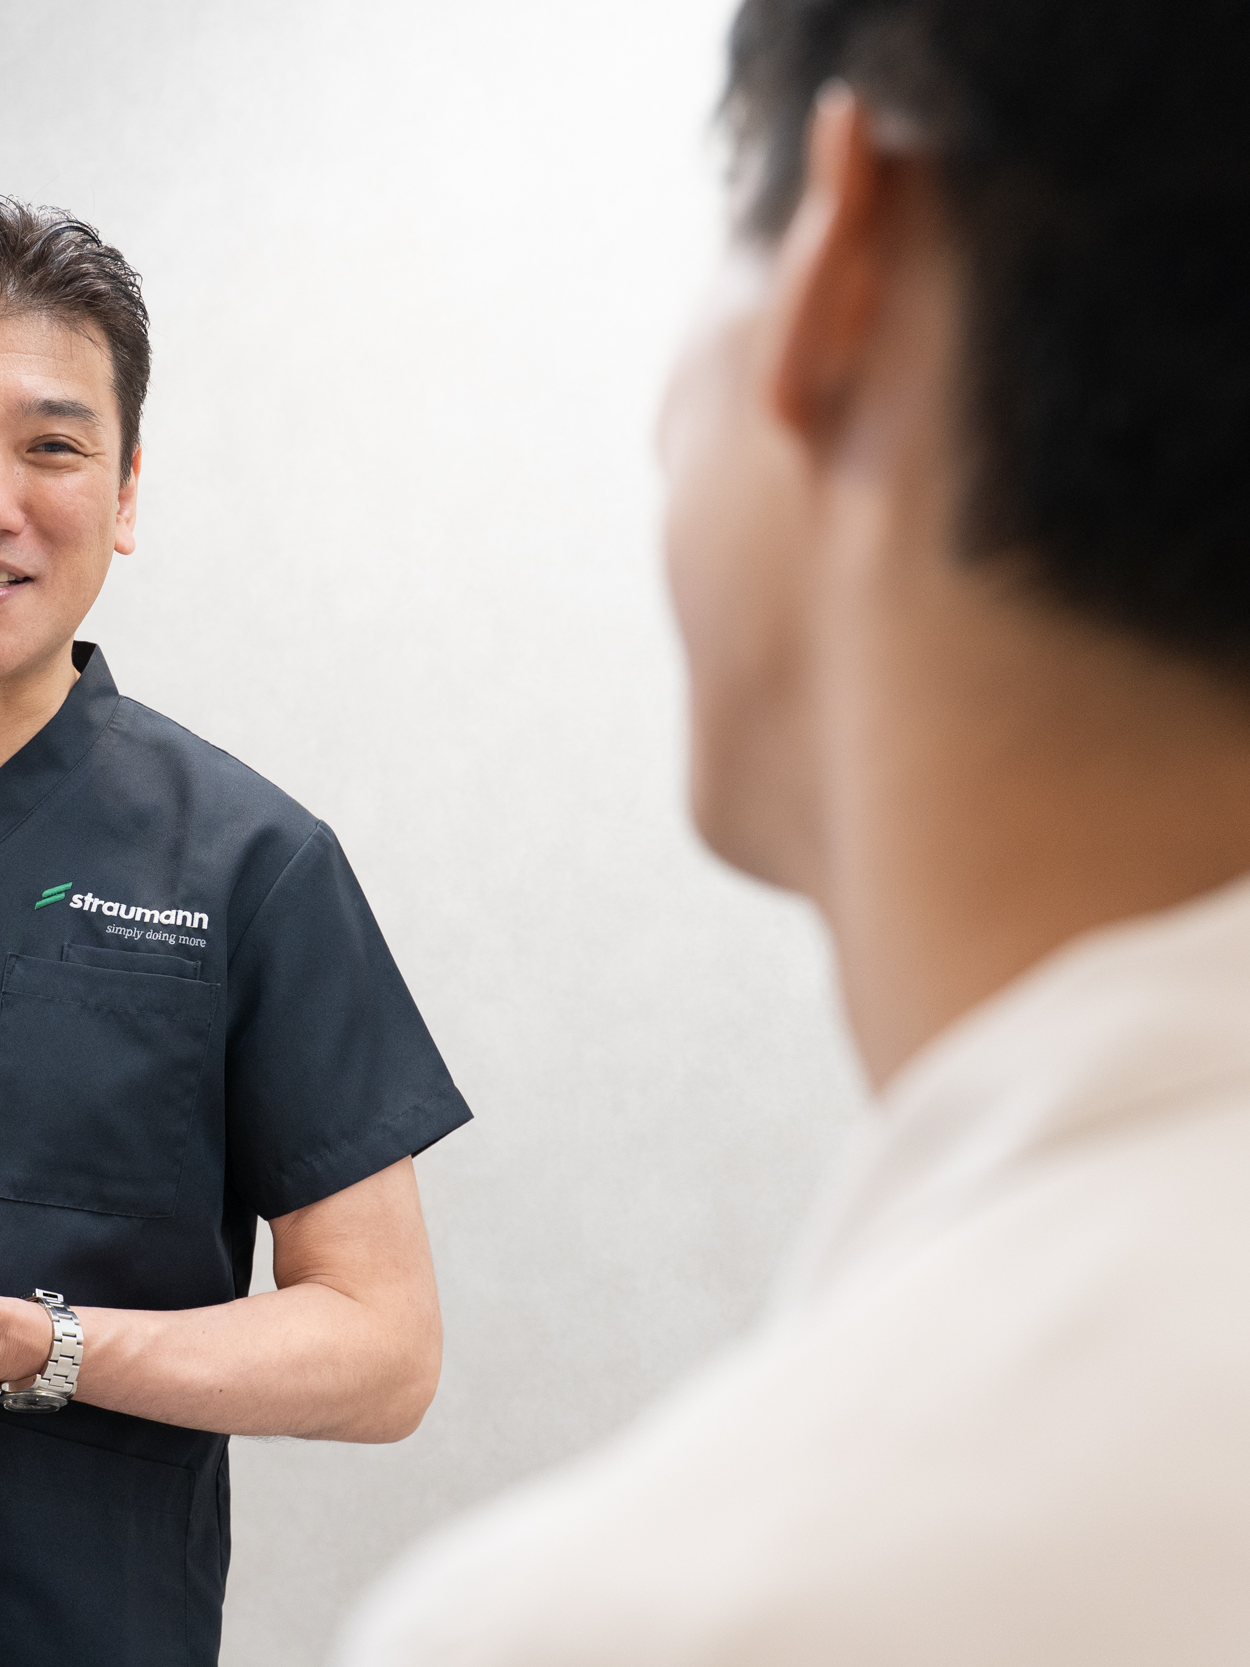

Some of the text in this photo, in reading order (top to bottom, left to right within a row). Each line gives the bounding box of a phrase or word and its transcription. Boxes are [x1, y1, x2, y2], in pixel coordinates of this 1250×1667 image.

[69, 892, 209, 929] straumann
[106, 924, 206, 947] simply doing more
